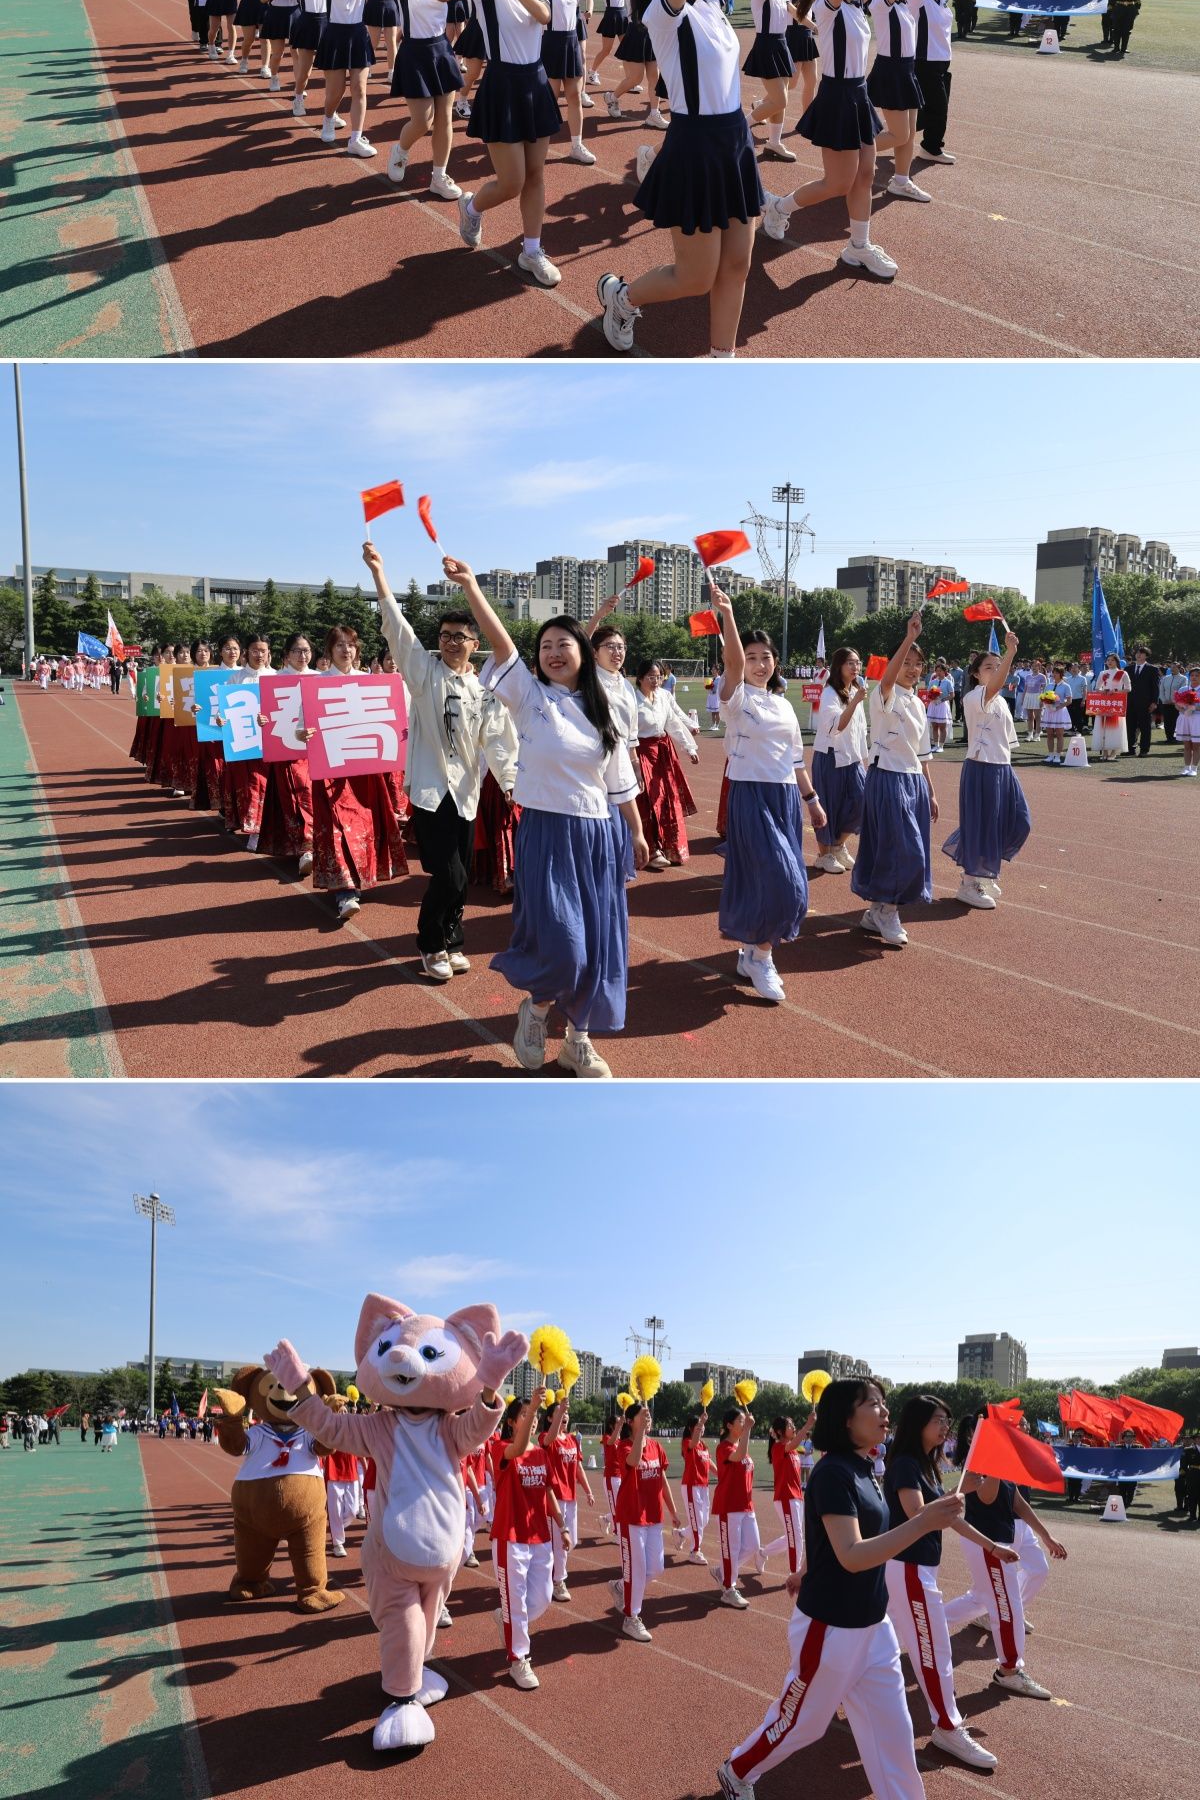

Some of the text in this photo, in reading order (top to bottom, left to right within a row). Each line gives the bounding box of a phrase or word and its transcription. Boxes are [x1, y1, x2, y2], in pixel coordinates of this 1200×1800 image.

[1046, 37, 1053, 45] 12
[317, 682, 399, 768] 青
[1072, 747, 1080, 756] 10
[522, 1475, 546, 1486] 追梦人
[1111, 1504, 1118, 1512] 12
